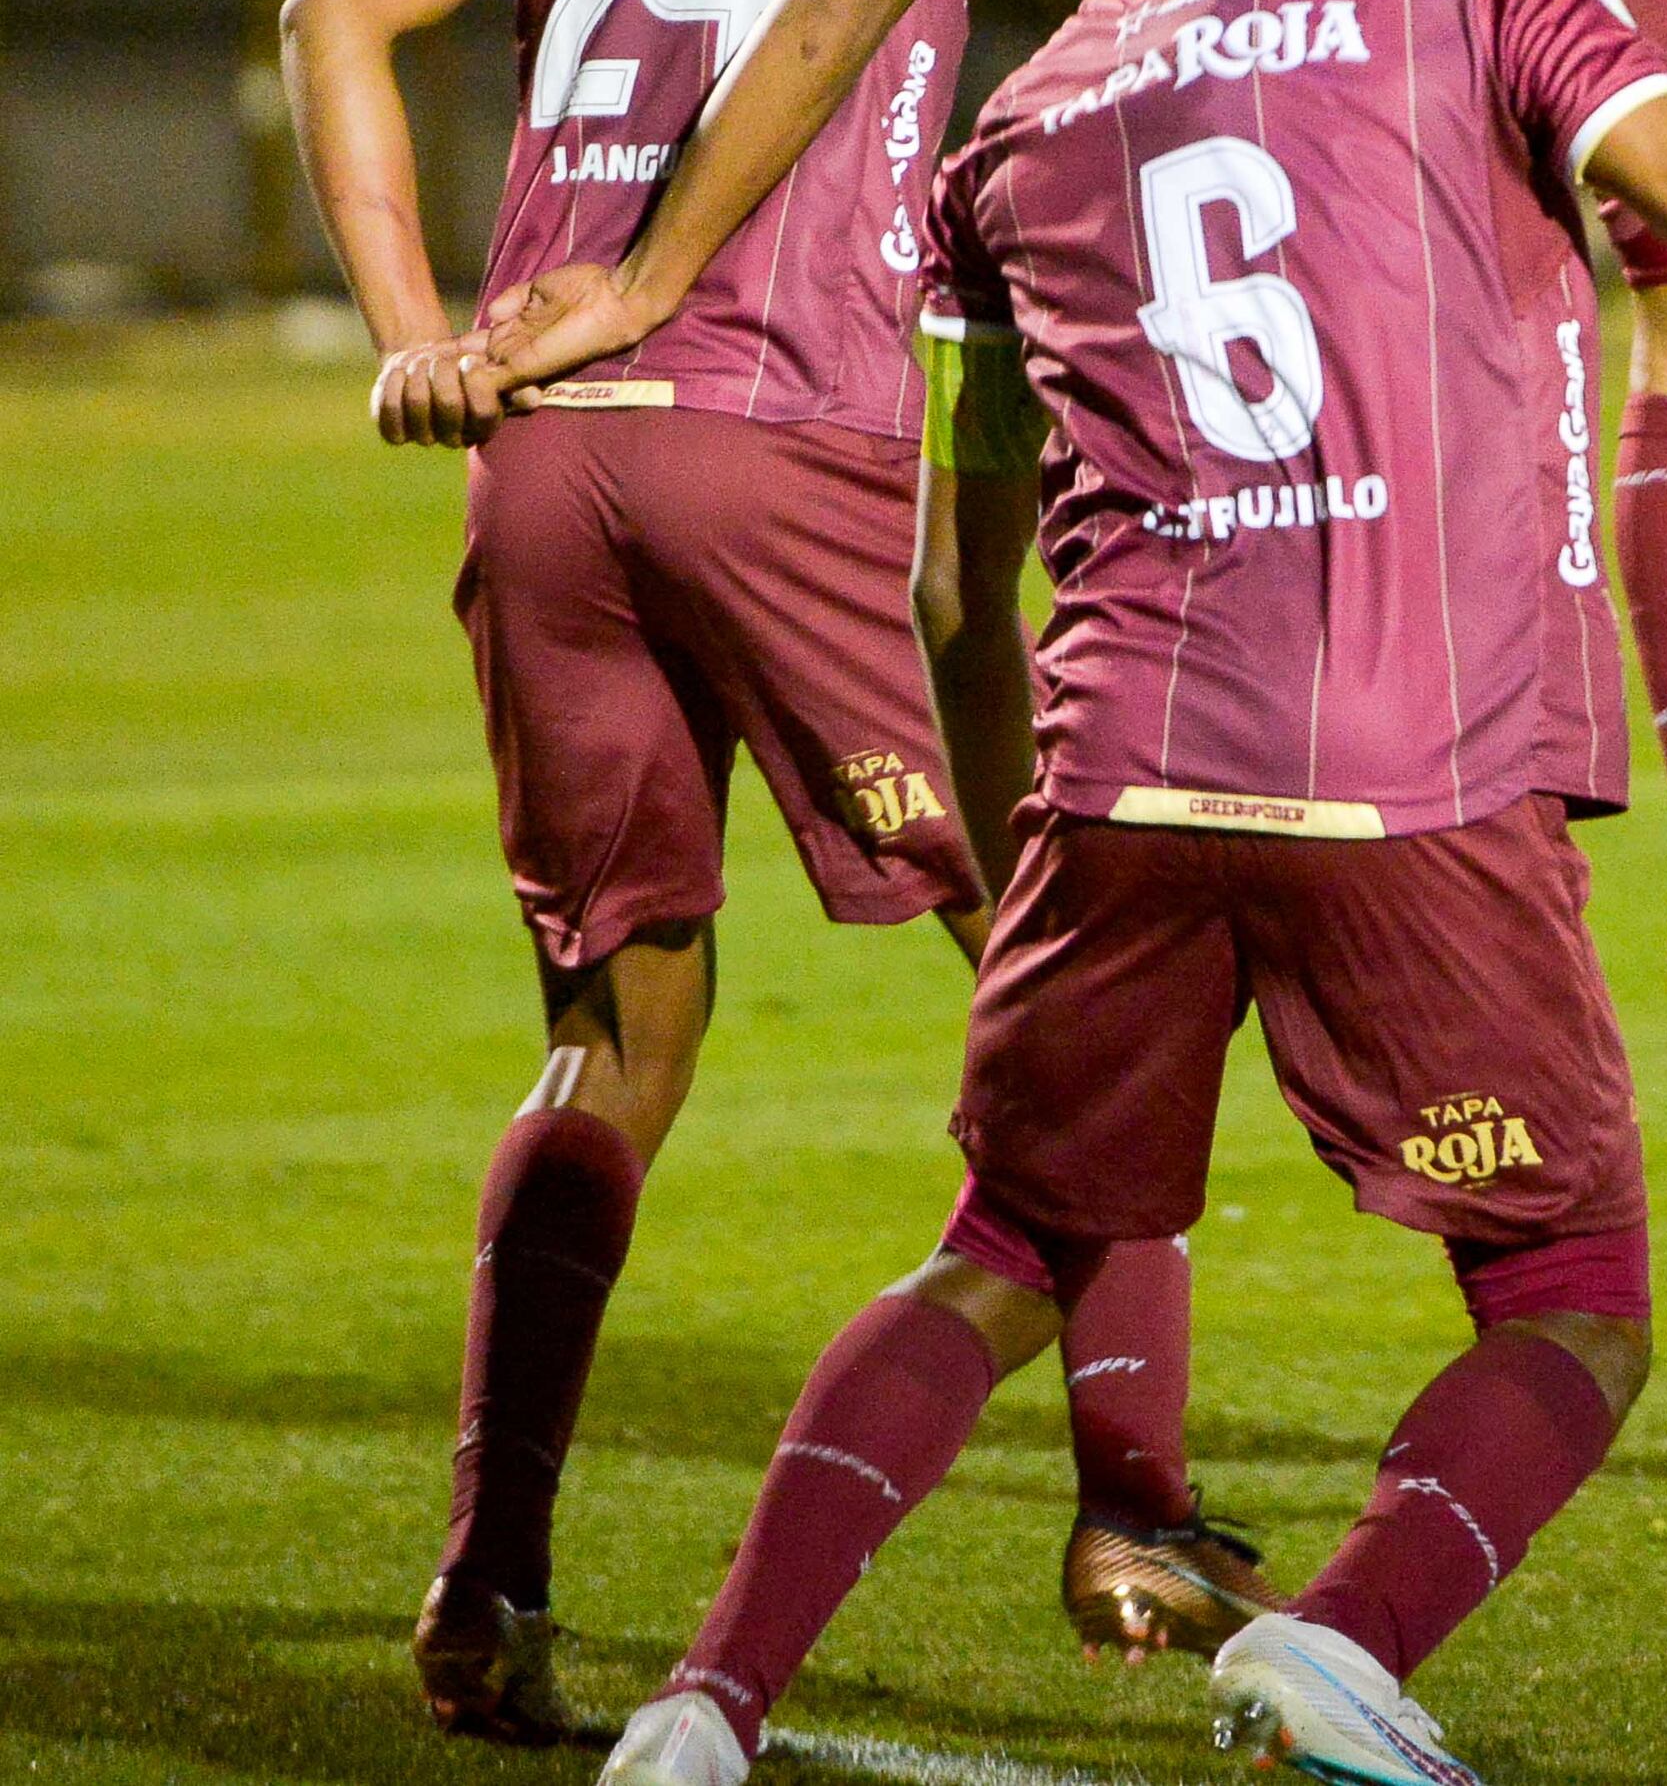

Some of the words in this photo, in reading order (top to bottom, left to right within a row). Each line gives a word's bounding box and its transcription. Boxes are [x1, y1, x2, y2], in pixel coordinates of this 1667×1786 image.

[1039, 49, 1173, 134] TAPA
[1173, 0, 1371, 91] ROJA
[1138, 136, 1324, 462] 6
[1399, 1117, 1544, 1184] ROJA
[1420, 1096, 1504, 1129] TAPA
